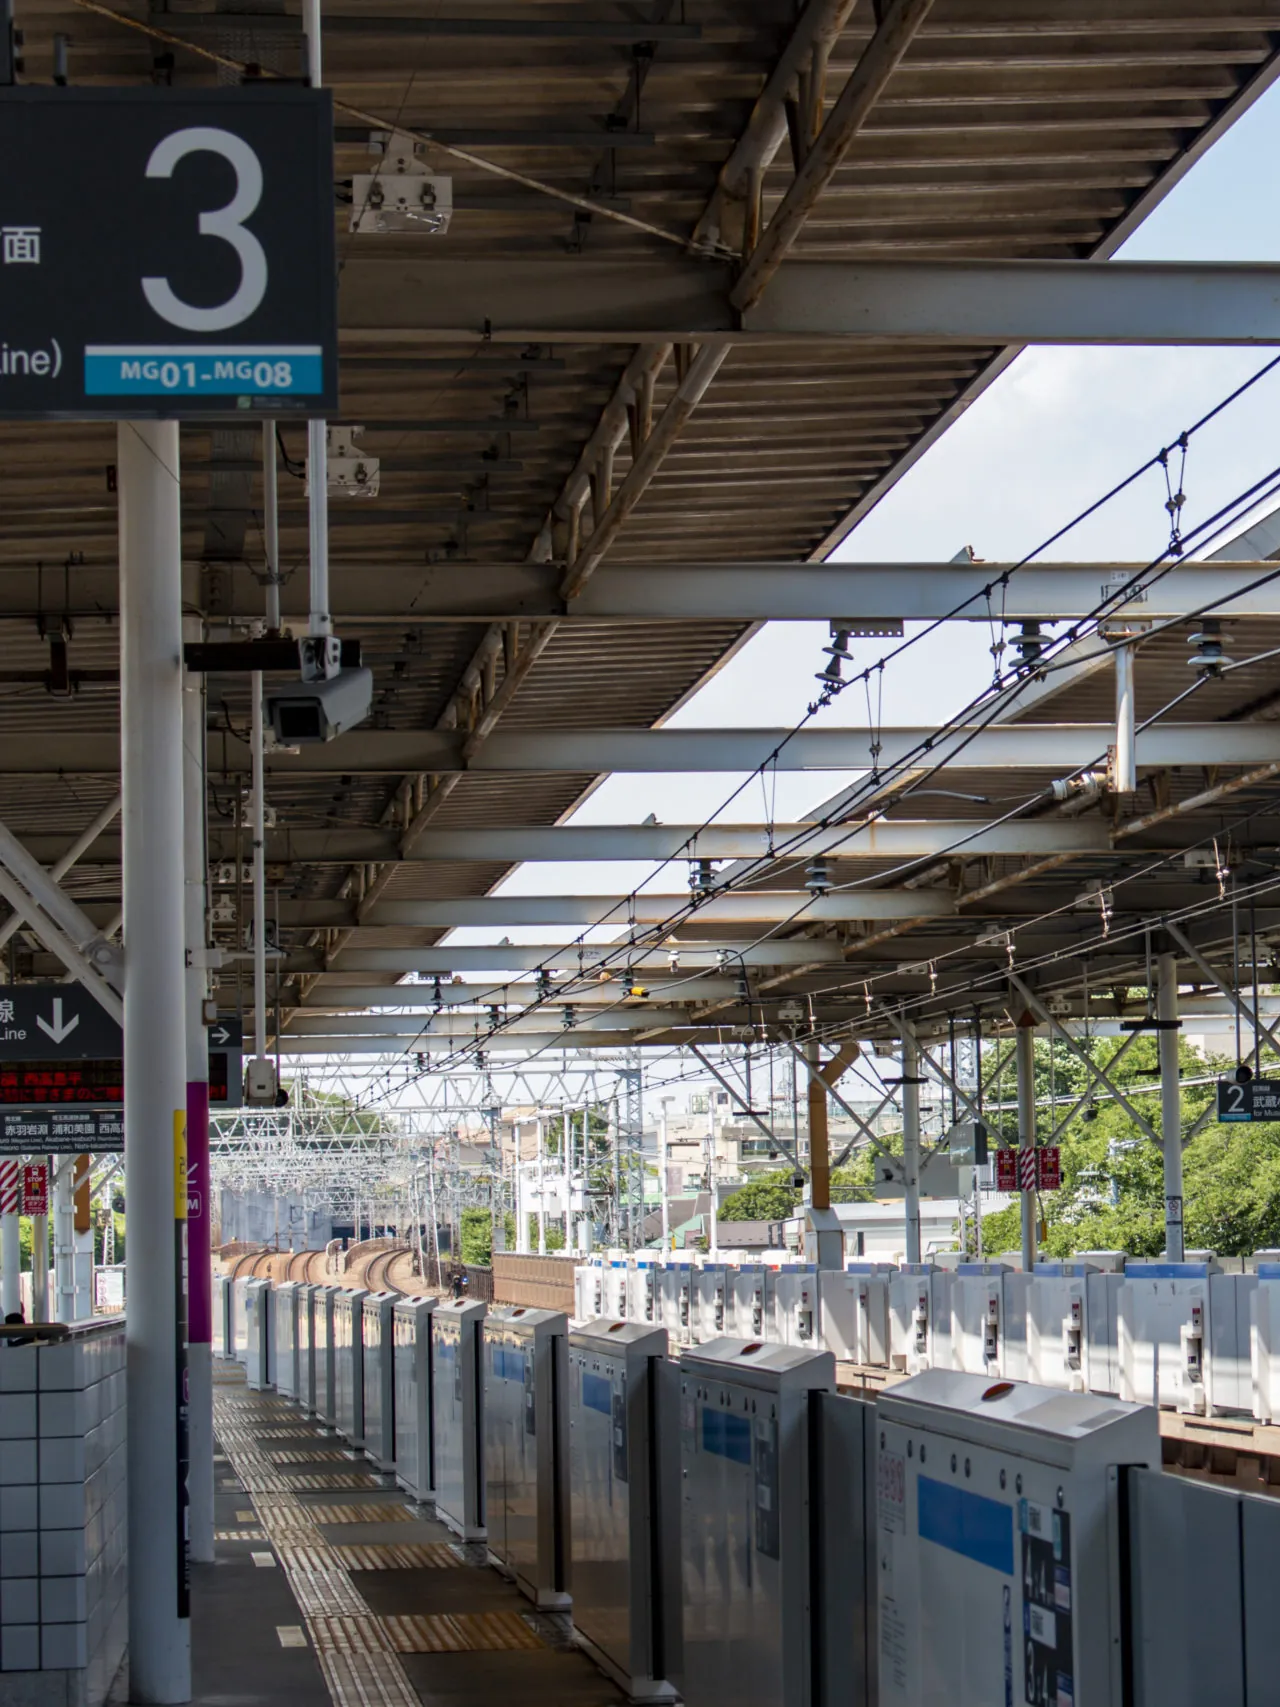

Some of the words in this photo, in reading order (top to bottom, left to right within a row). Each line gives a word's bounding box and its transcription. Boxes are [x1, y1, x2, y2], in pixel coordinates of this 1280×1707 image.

[141, 126, 269, 333] 3
[0, 225, 42, 265] 面
[0, 337, 63, 380] ine)
[120, 360, 293, 389] MG01-MG08
[1227, 1085, 1245, 1113] 2
[52, 1122, 95, 1135] 浦和美園
[99, 1122, 124, 1134] 西高
[187, 1198, 199, 1209] M
